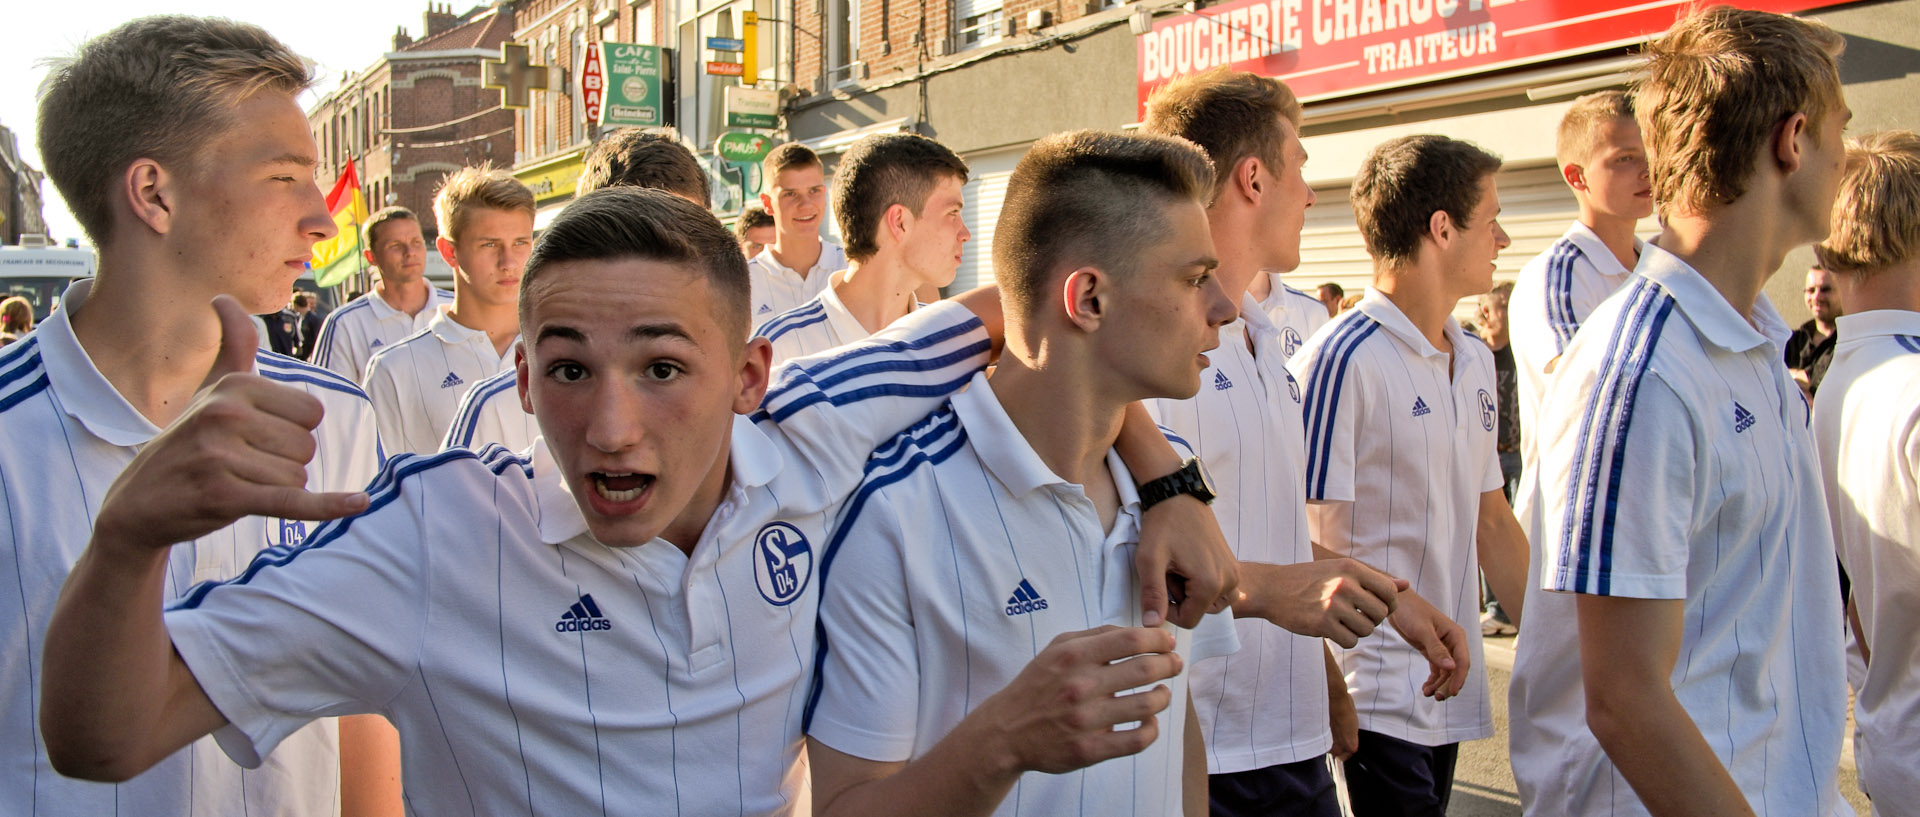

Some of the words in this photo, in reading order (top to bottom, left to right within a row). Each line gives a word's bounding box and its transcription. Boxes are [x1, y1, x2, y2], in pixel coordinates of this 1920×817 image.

[1143, 0, 1302, 82] BOUCHERIE
[1364, 21, 1497, 75] TRAITEUR
[585, 44, 602, 119] TABAC
[441, 379, 464, 388] adidas
[285, 525, 304, 546] 04
[765, 530, 787, 574] S
[776, 569, 794, 595] 04
[1005, 599, 1048, 616] adidas
[556, 617, 611, 632] adidas
